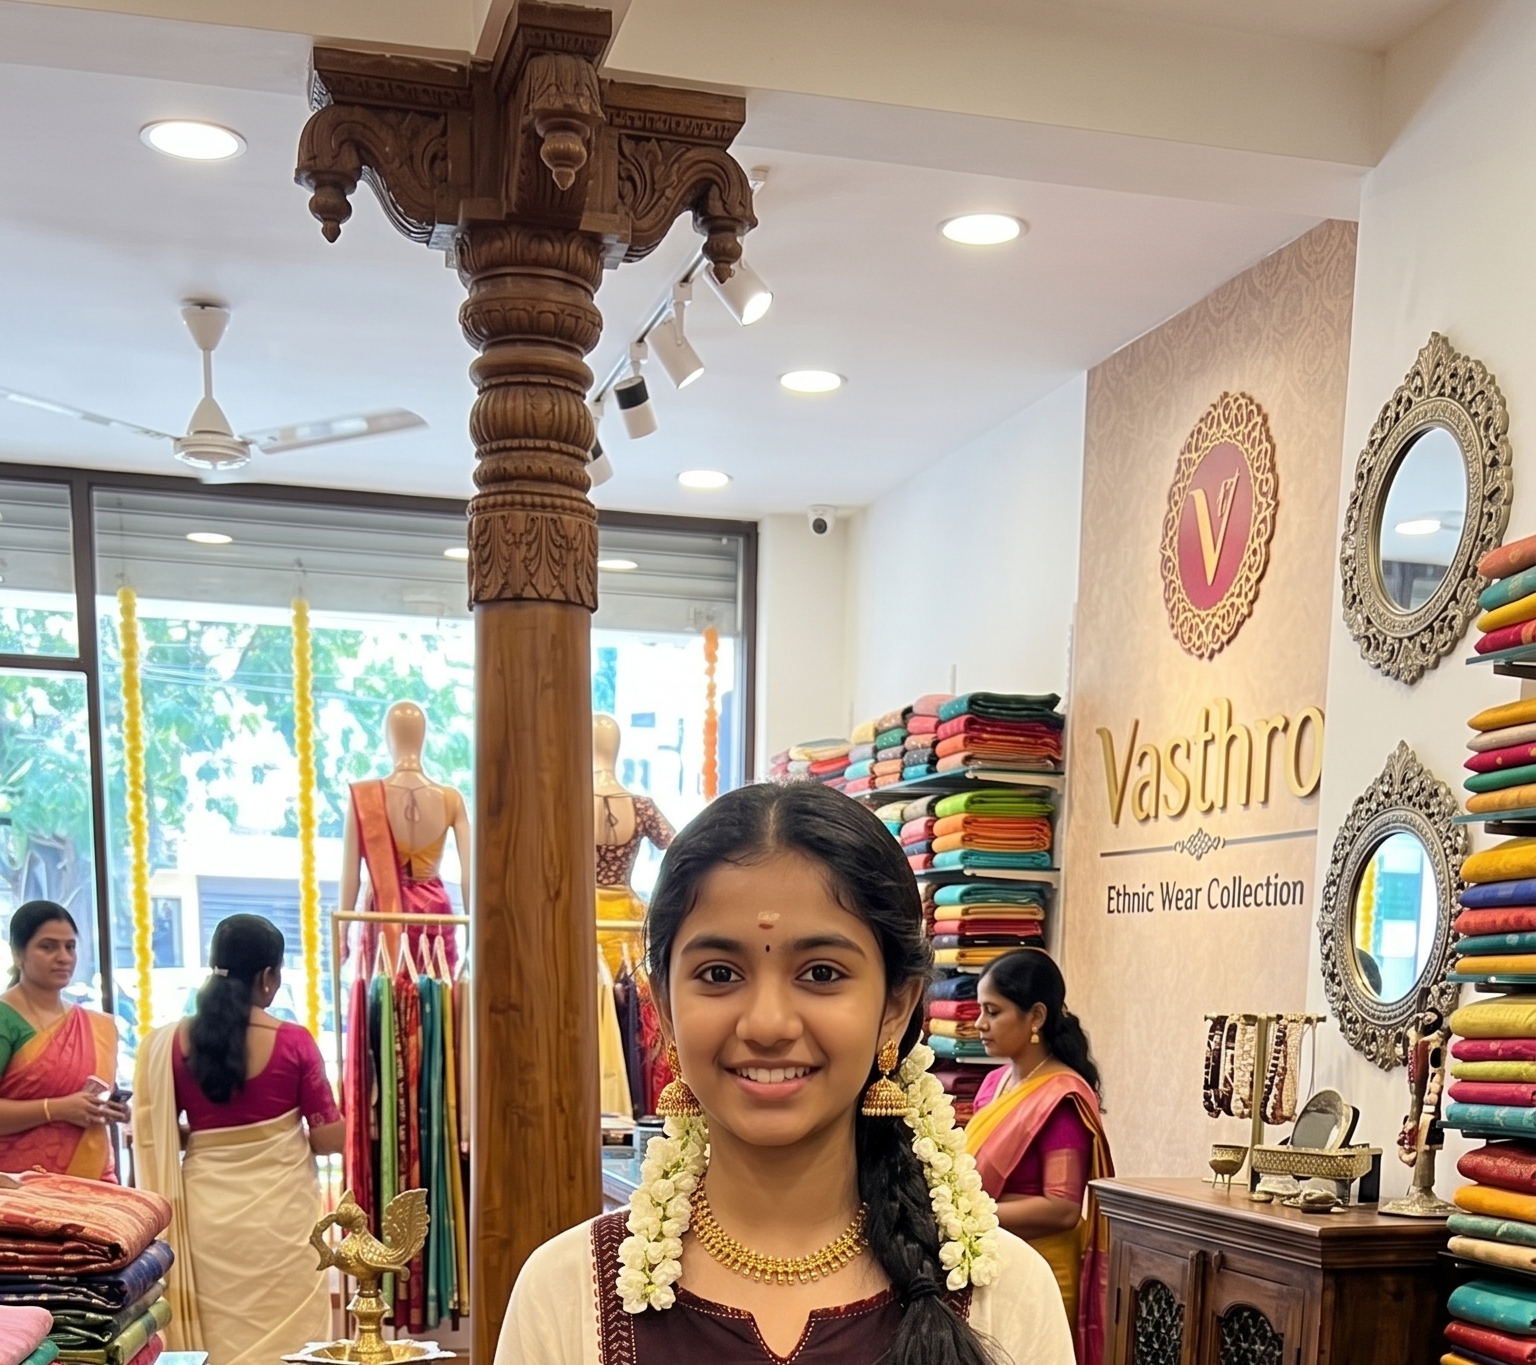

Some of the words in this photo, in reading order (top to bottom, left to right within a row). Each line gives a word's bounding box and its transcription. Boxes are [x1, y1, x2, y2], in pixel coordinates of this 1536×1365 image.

[1189, 467, 1240, 586] V
[1096, 698, 1325, 826] Vasthro
[1107, 883, 1155, 914] Ethnic
[1160, 880, 1203, 912] Wear
[1207, 873, 1305, 910] Collection
